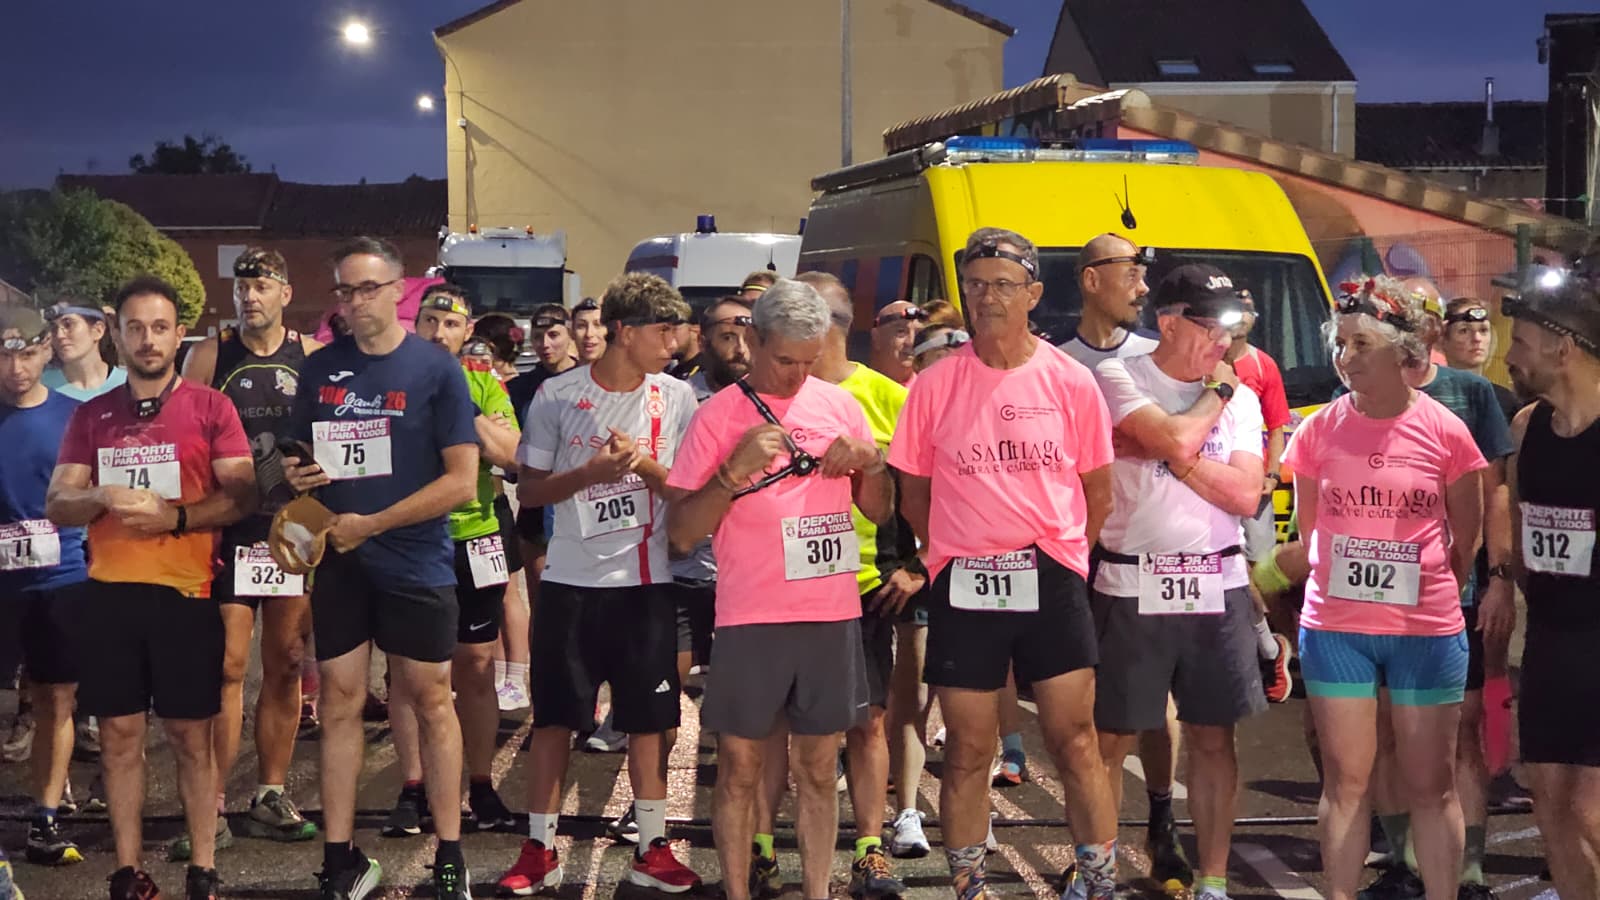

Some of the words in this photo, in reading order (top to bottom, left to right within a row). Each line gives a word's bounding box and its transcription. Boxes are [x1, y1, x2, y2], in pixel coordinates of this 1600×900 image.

[329, 418, 387, 433] DEPORTE
[331, 431, 356, 440] PARA
[358, 428, 387, 438] TODOS
[114, 443, 176, 457] DEPORTE
[569, 435, 668, 455] ASRE
[114, 456, 139, 466] PARA
[142, 453, 176, 463] TODOS
[341, 443, 365, 466] 75
[126, 467, 151, 489] 74
[595, 495, 635, 523] 205
[1528, 505, 1592, 520] DEPORTE
[800, 512, 849, 529] DEPORTE
[1554, 520, 1592, 530] TODOS
[801, 527, 826, 537] PARA
[829, 522, 852, 533] TODOS
[12, 538, 32, 557] 77
[806, 536, 842, 564] 301
[1347, 538, 1419, 553] DEPORTE
[1532, 530, 1570, 559] 312
[1347, 548, 1376, 558] PARA
[1379, 551, 1418, 562] TODOS
[968, 560, 994, 569] PARA
[997, 560, 1033, 570] TODOS
[1156, 565, 1182, 573] PARA
[1185, 565, 1218, 573] TODOS
[252, 566, 285, 585] 323
[1347, 561, 1396, 589] 302
[975, 573, 1011, 596] 311
[1161, 577, 1201, 601] 314
